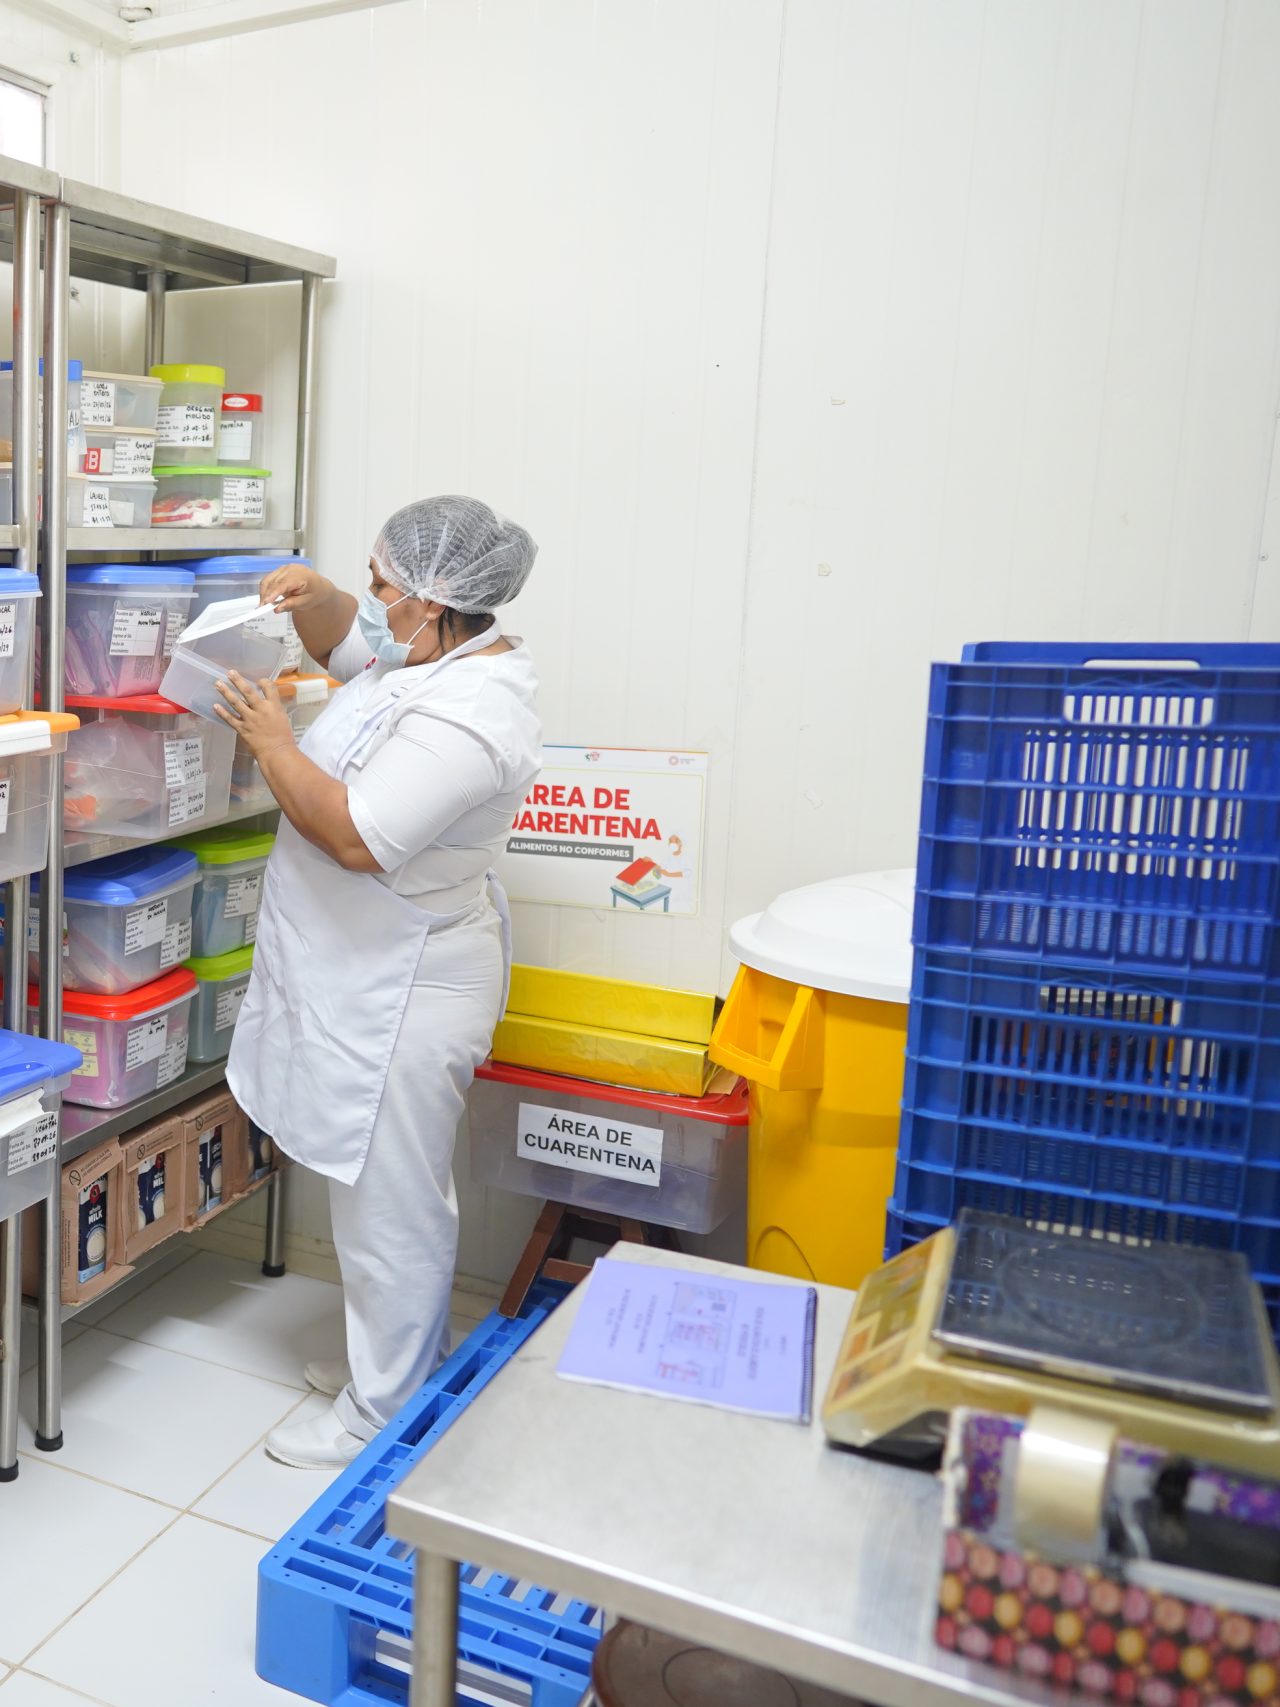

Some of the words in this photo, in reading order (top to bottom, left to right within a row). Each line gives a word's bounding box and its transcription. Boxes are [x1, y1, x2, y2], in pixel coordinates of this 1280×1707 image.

[593, 787, 630, 810] DE
[512, 811, 662, 840] ARENTENA
[510, 841, 557, 852] ALIMENTOS
[559, 846, 573, 854] NO
[575, 847, 631, 858] CONFORMES
[547, 1113, 600, 1141] ÁREA
[606, 1127, 633, 1147] DE
[524, 1133, 657, 1174] CUARENTENA
[88, 1209, 103, 1225] MILK
